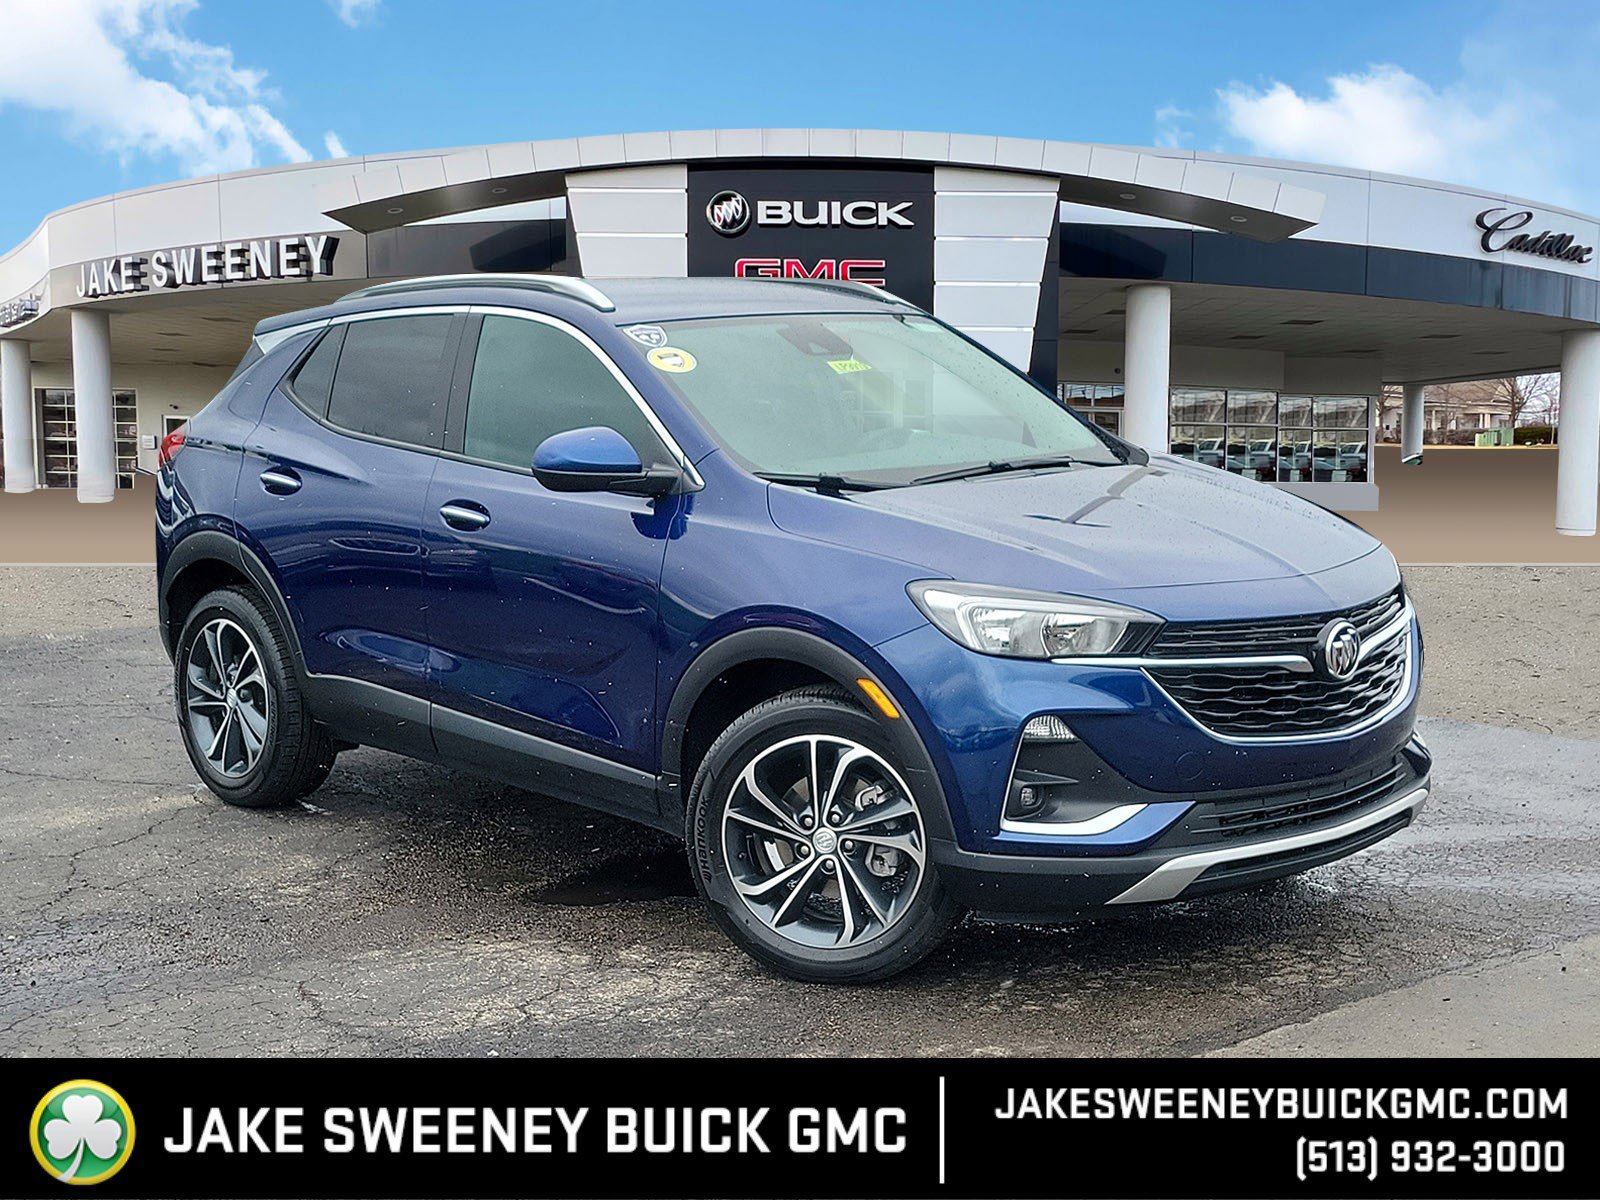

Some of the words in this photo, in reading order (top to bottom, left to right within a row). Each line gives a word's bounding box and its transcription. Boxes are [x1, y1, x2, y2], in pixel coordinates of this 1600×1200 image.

[756, 200, 914, 227] BUICK
[1475, 207, 1594, 264] Cadillac
[76, 256, 140, 298] JAKE
[151, 234, 330, 288] SWEENEY
[734, 258, 886, 286] GMC
